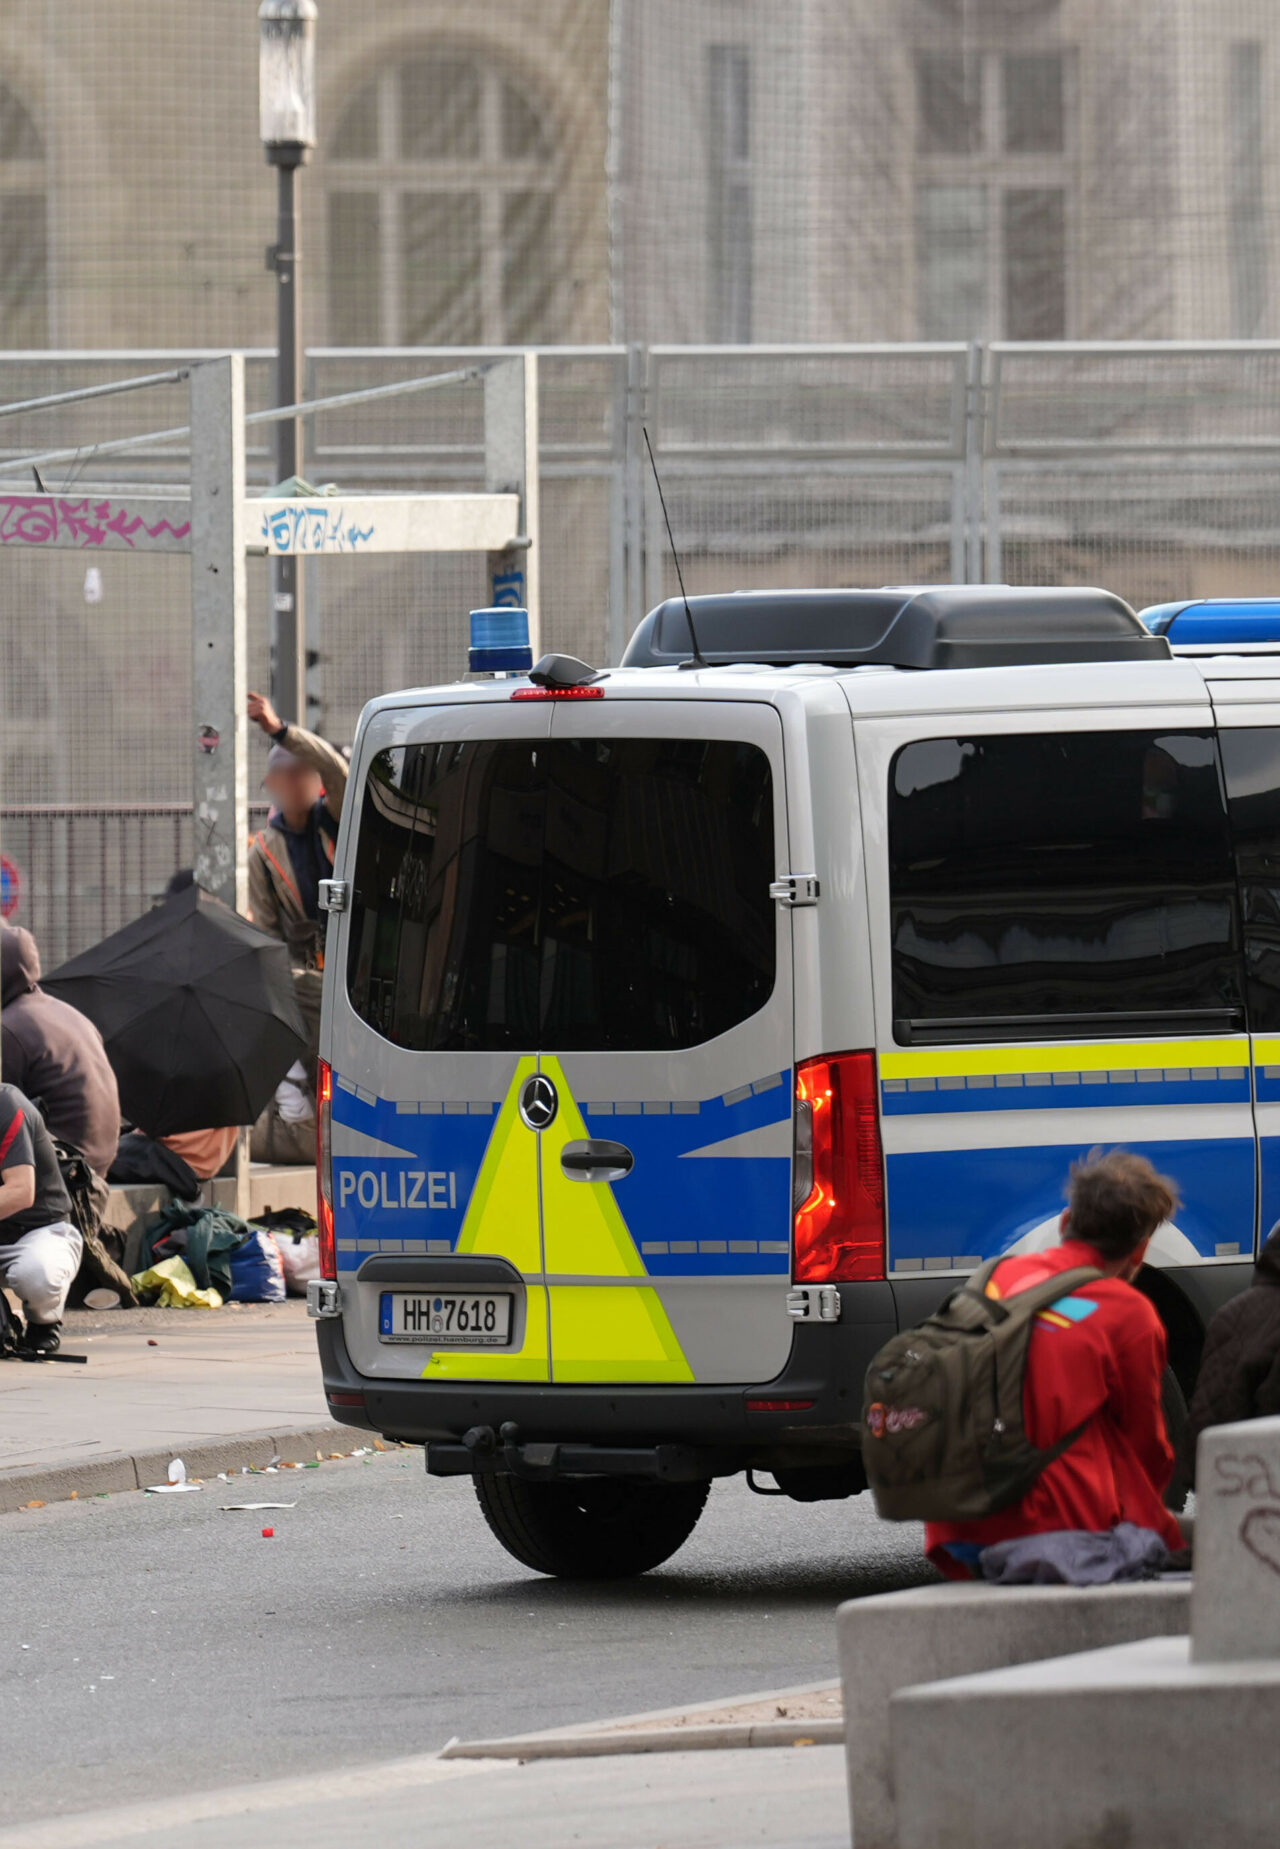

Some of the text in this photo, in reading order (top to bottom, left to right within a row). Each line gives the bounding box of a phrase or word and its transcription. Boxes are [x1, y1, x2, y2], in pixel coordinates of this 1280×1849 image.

[340, 1170, 457, 1209] POLIZEI
[403, 1299, 496, 1332] HH 7618
